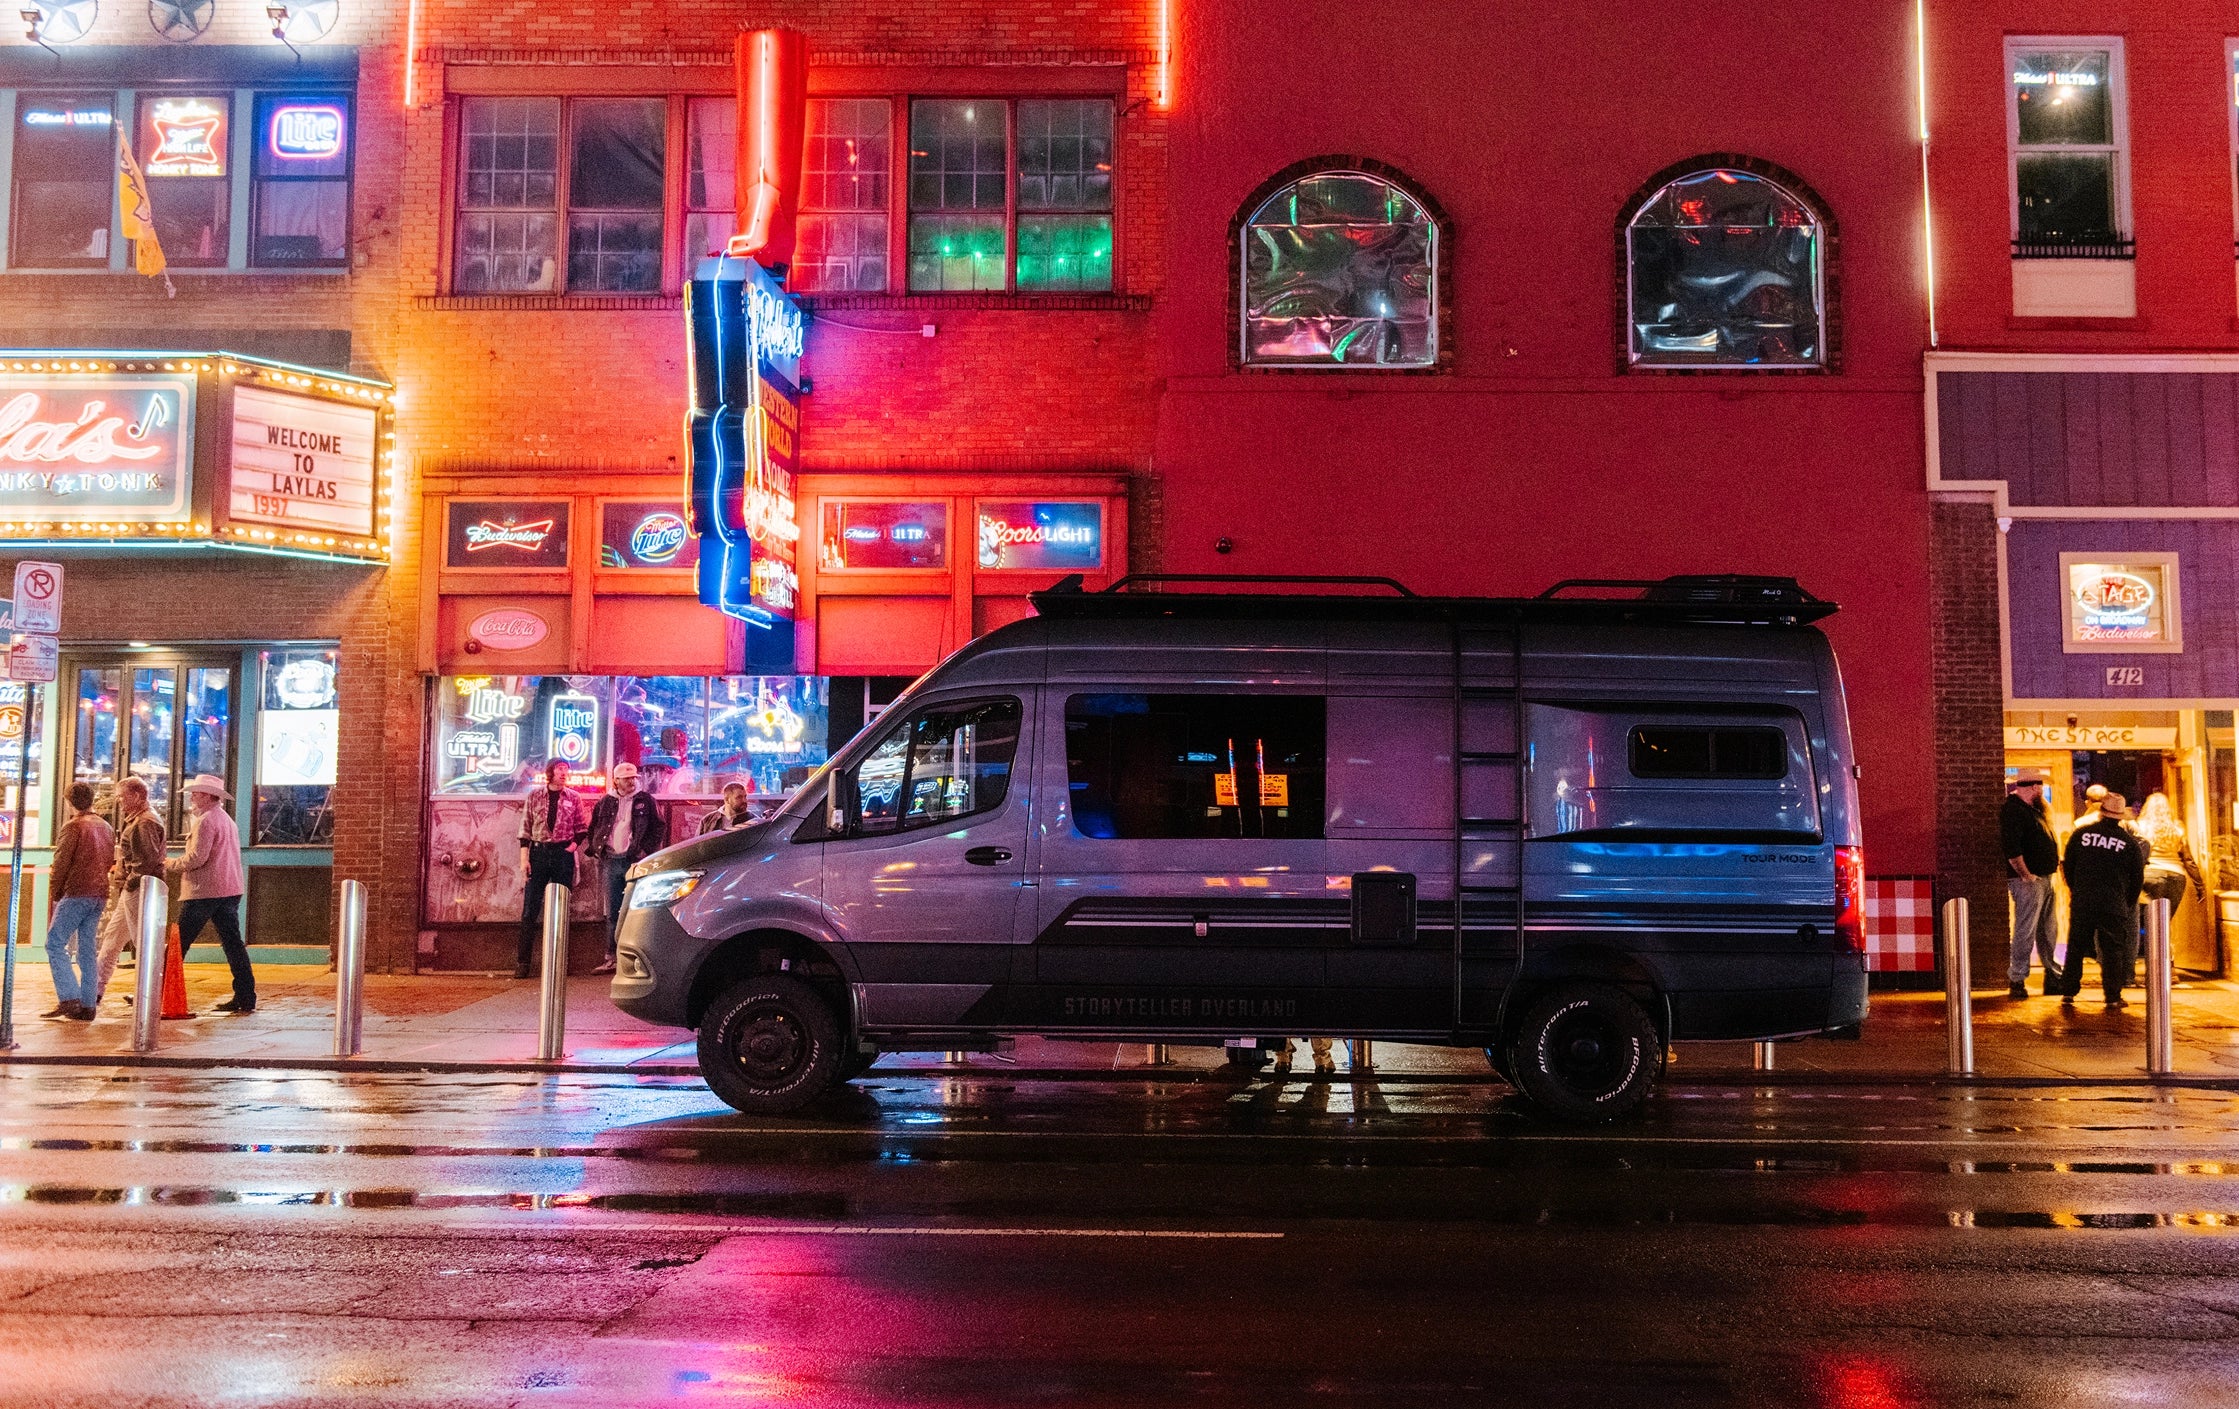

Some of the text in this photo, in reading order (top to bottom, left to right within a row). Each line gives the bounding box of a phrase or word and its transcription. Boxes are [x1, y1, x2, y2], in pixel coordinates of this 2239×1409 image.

[2055, 73, 2097, 85] ULTRA
[281, 115, 336, 147] Lite
[267, 426, 341, 454] WELCOME
[294, 453, 314, 474] TO
[78, 473, 162, 492] TONK
[273, 474, 337, 500] LAYLAS
[253, 494, 289, 517] 1997
[466, 526, 549, 542] Budweiser
[891, 528, 931, 540] ULTRA
[995, 521, 1091, 542] Coors LIGHT
[2083, 584, 2148, 605] STAGE
[2085, 615, 2099, 625] ON
[2077, 625, 2158, 640] Budweiser
[2110, 669, 2141, 685] 412
[554, 708, 594, 732] Lite
[2016, 728, 2134, 744] THE STAGE
[448, 742, 499, 756] ULTRA
[585, 776, 605, 785] TIME
[2081, 833, 2126, 852] STAFF
[1741, 854, 1816, 864] TOUR MODE
[1064, 997, 1297, 1018] STORYTELLER OVERLAND
[1538, 1000, 1590, 1074] All-Terrain T/A
[1595, 1036, 1640, 1102] BFGoodrich
